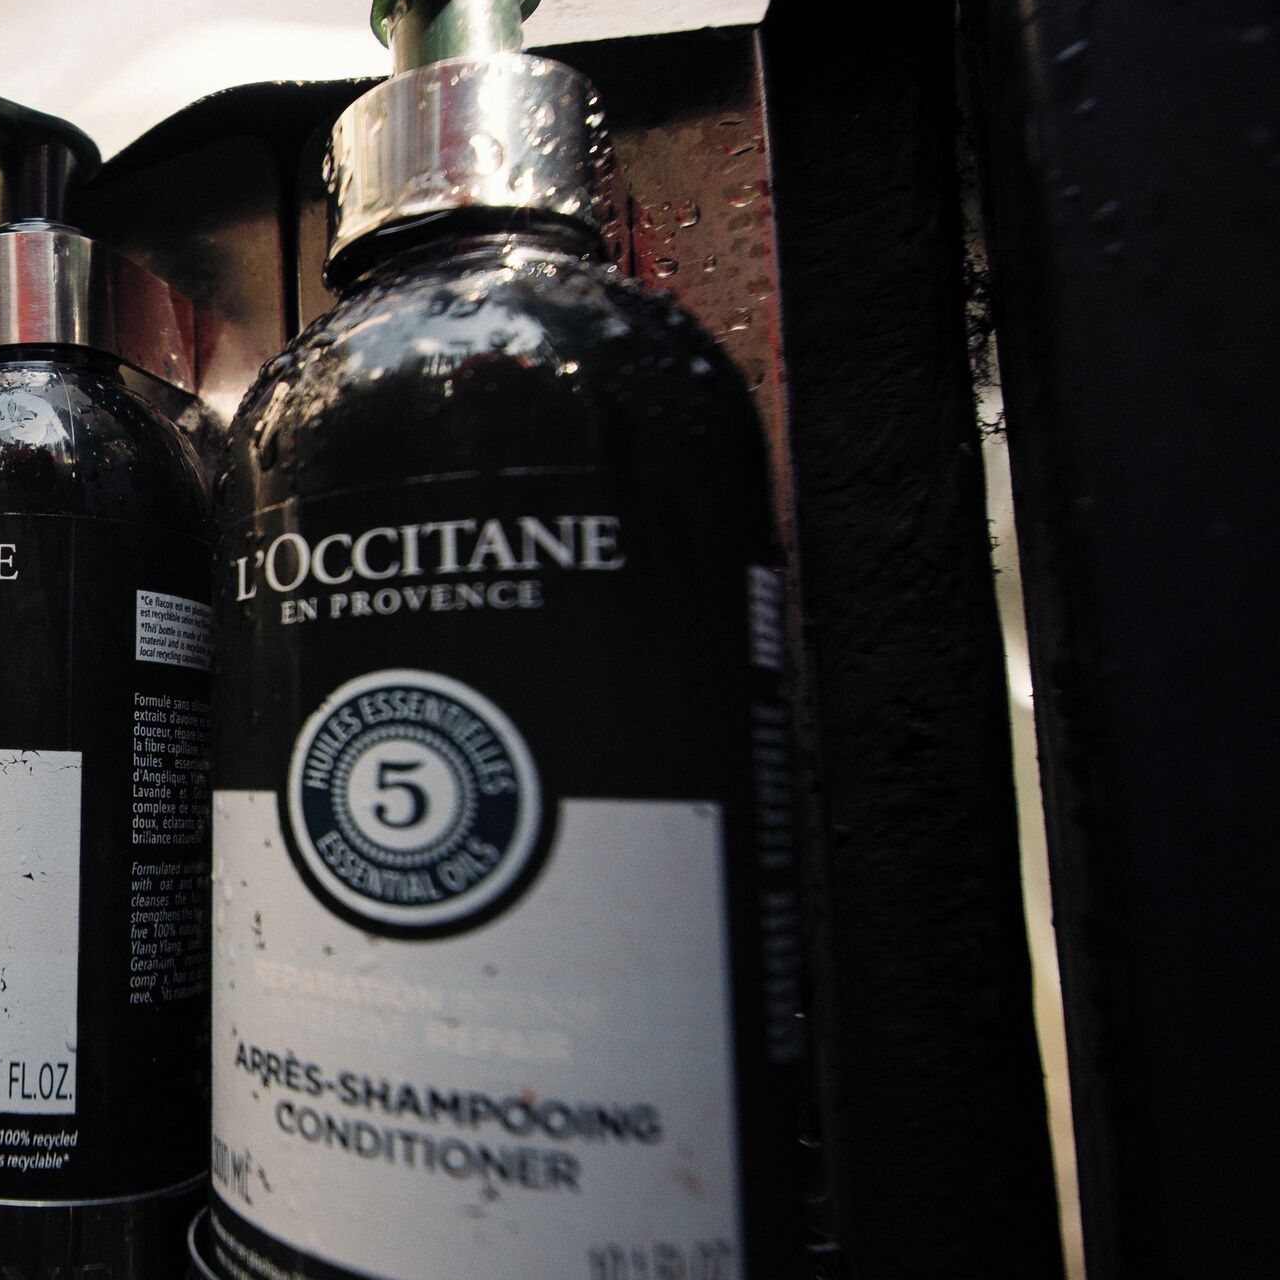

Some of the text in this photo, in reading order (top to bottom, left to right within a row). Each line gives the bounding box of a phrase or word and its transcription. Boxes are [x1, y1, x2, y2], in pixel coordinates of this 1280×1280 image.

[234, 516, 626, 602] L'OCCITANE
[281, 580, 545, 624] EN PROVENCE
[134, 692, 171, 709] Formulé
[134, 710, 167, 723] extraits
[133, 723, 172, 741] douceur,
[133, 738, 142, 751] la
[145, 738, 166, 754] fibre
[304, 689, 518, 795] HUILES ESSENTIELLES
[133, 752, 162, 768] huiles
[132, 769, 188, 787] d'Angélique,
[133, 784, 172, 799] Lavande
[373, 760, 428, 828] 5
[132, 800, 176, 818] complexe
[132, 816, 159, 831] doux,
[132, 830, 171, 845] brillance
[131, 861, 181, 876] Formulated
[131, 876, 152, 892] with
[131, 892, 170, 908] cleanses
[131, 941, 158, 958] Ylang
[8, 1061, 72, 1100] FL.OZ.
[234, 1041, 664, 1145] APRÈS-SHAMPOOING
[32, 1130, 78, 1152] recycled
[275, 1097, 582, 1192] CONDITIONER
